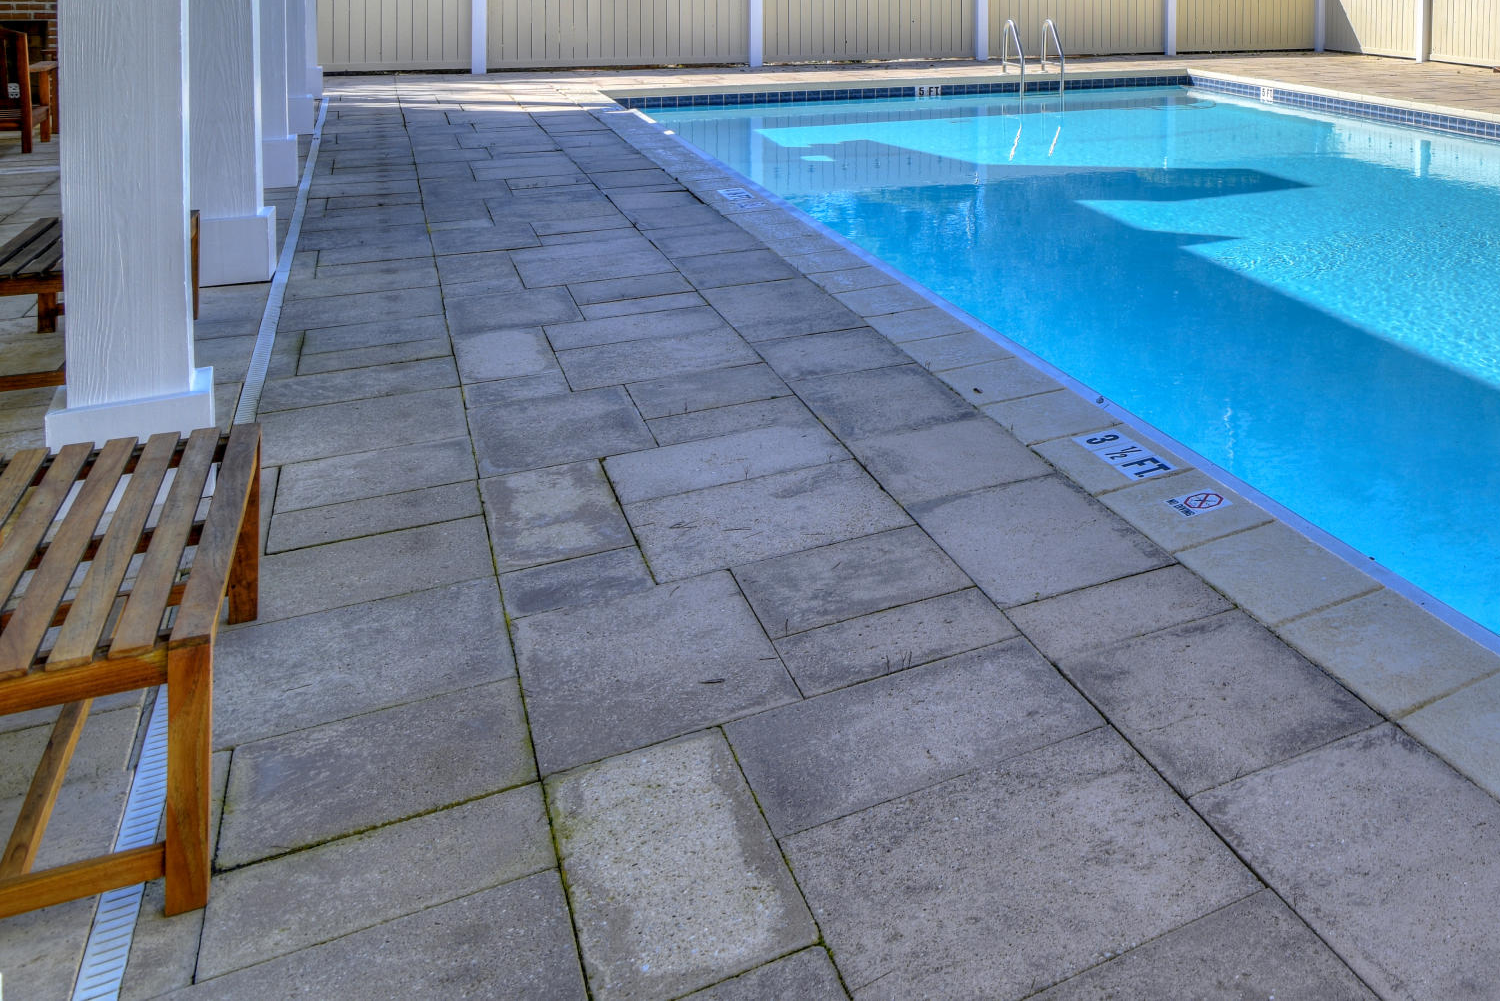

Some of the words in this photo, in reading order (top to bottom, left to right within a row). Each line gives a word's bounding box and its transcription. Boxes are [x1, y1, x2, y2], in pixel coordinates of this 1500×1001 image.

[919, 87, 925, 96] 5
[1086, 434, 1120, 445] 3
[1121, 456, 1171, 478] FT.
